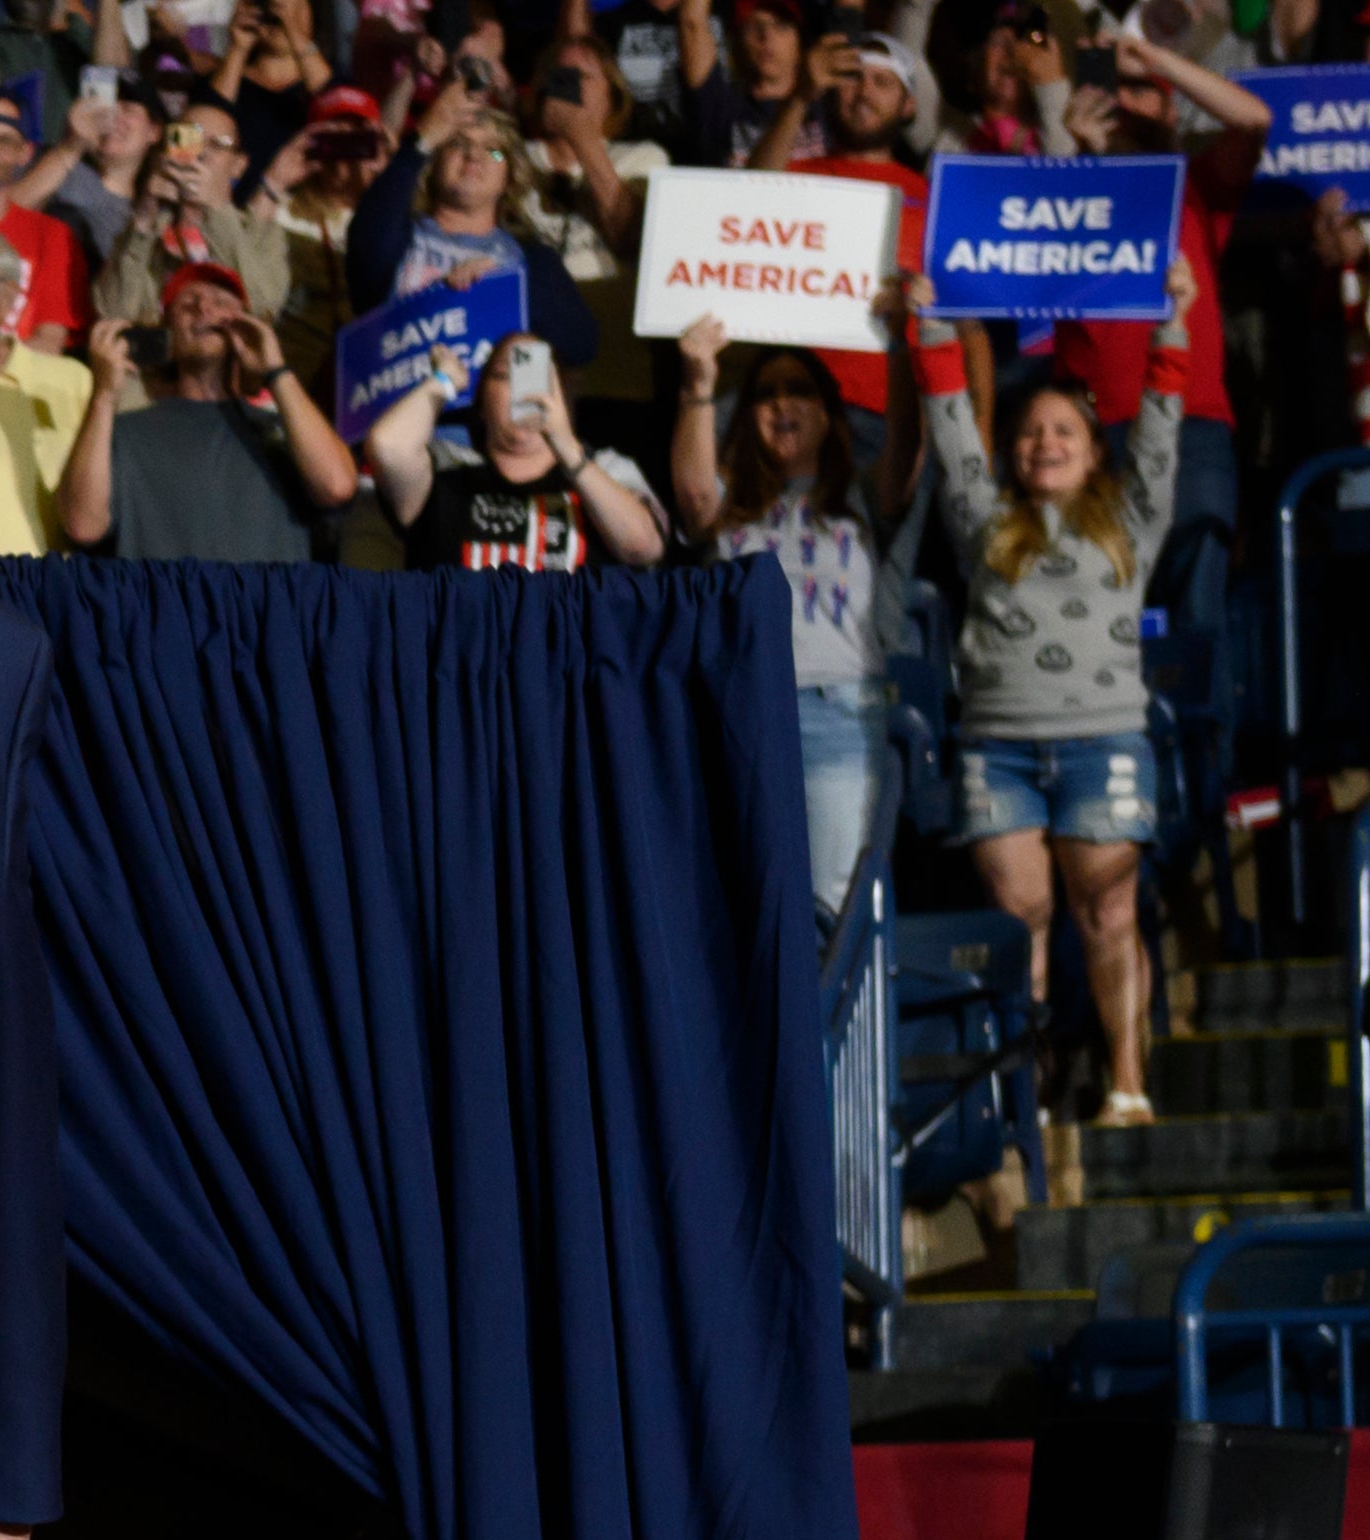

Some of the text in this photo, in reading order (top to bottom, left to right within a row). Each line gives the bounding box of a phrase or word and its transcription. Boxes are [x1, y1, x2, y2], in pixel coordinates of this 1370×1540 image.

[719, 214, 826, 250] SAVE
[1000, 196, 1111, 231] SAVE
[945, 237, 1157, 275] AMERICA!
[666, 258, 871, 299] AMERICA!
[381, 306, 468, 359] SAVE
